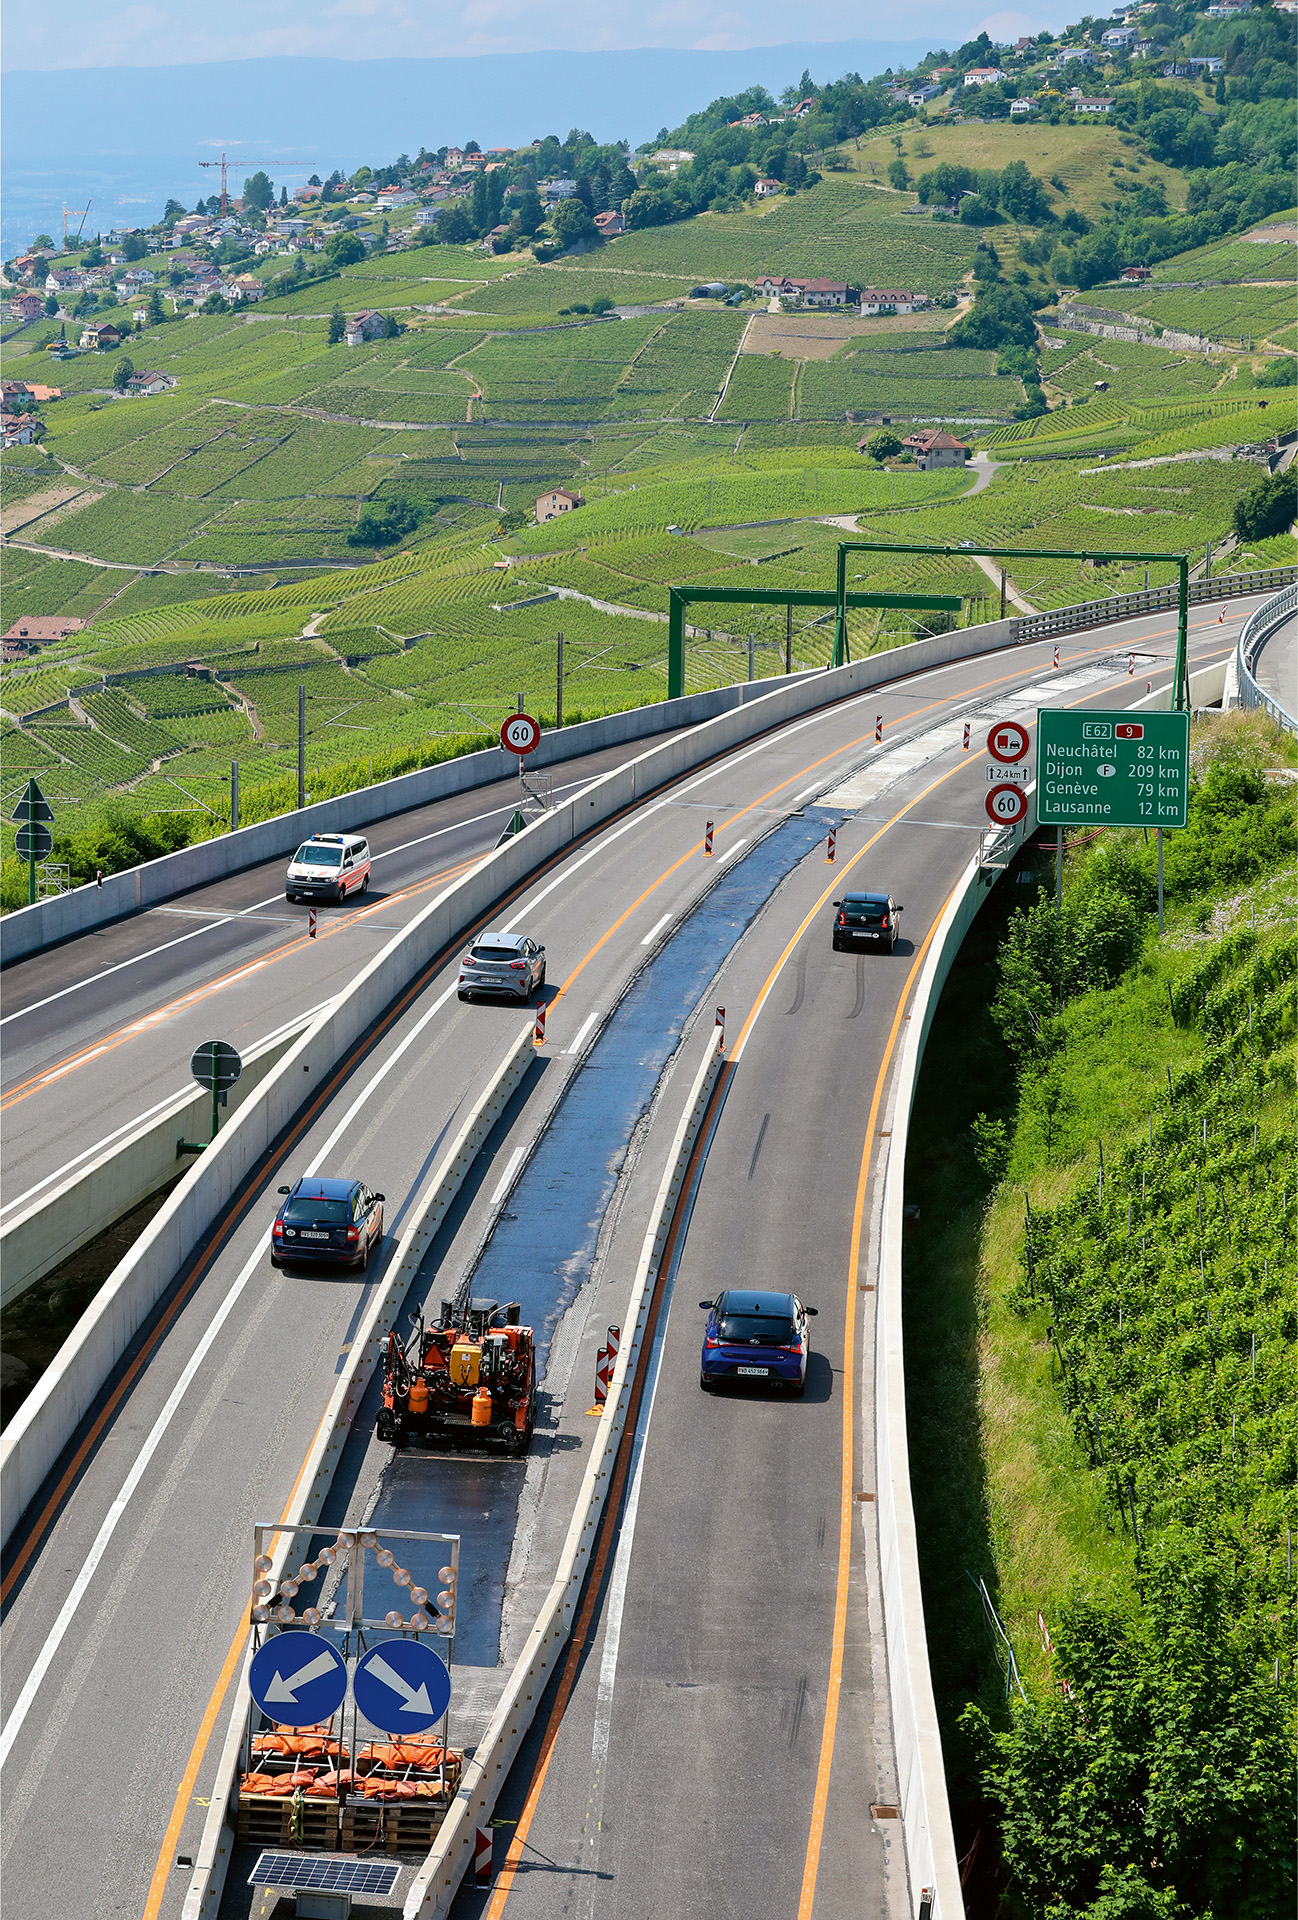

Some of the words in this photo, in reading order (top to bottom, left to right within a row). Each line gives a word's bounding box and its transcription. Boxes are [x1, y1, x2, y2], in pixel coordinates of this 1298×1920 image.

[512, 726, 529, 741] 60
[1094, 726, 1107, 737] 62
[1126, 726, 1133, 737] 9
[1046, 744, 1117, 758] Neuchâtel
[1137, 746, 1154, 759] 82
[1159, 746, 1180, 760] km
[996, 768, 1009, 779] 2,4
[1010, 770, 1020, 778] km
[1046, 763, 1082, 779] Dijon
[1103, 766, 1109, 775] F
[1128, 765, 1154, 778] 209
[1159, 765, 1179, 779] km
[1046, 781, 1098, 795] Genève
[1137, 783, 1153, 797] 79
[1158, 783, 1179, 797] km
[998, 797, 1015, 812] 60
[1045, 799, 1111, 814] Lausanne
[1138, 802, 1153, 815] 12
[1157, 802, 1178, 816] km
